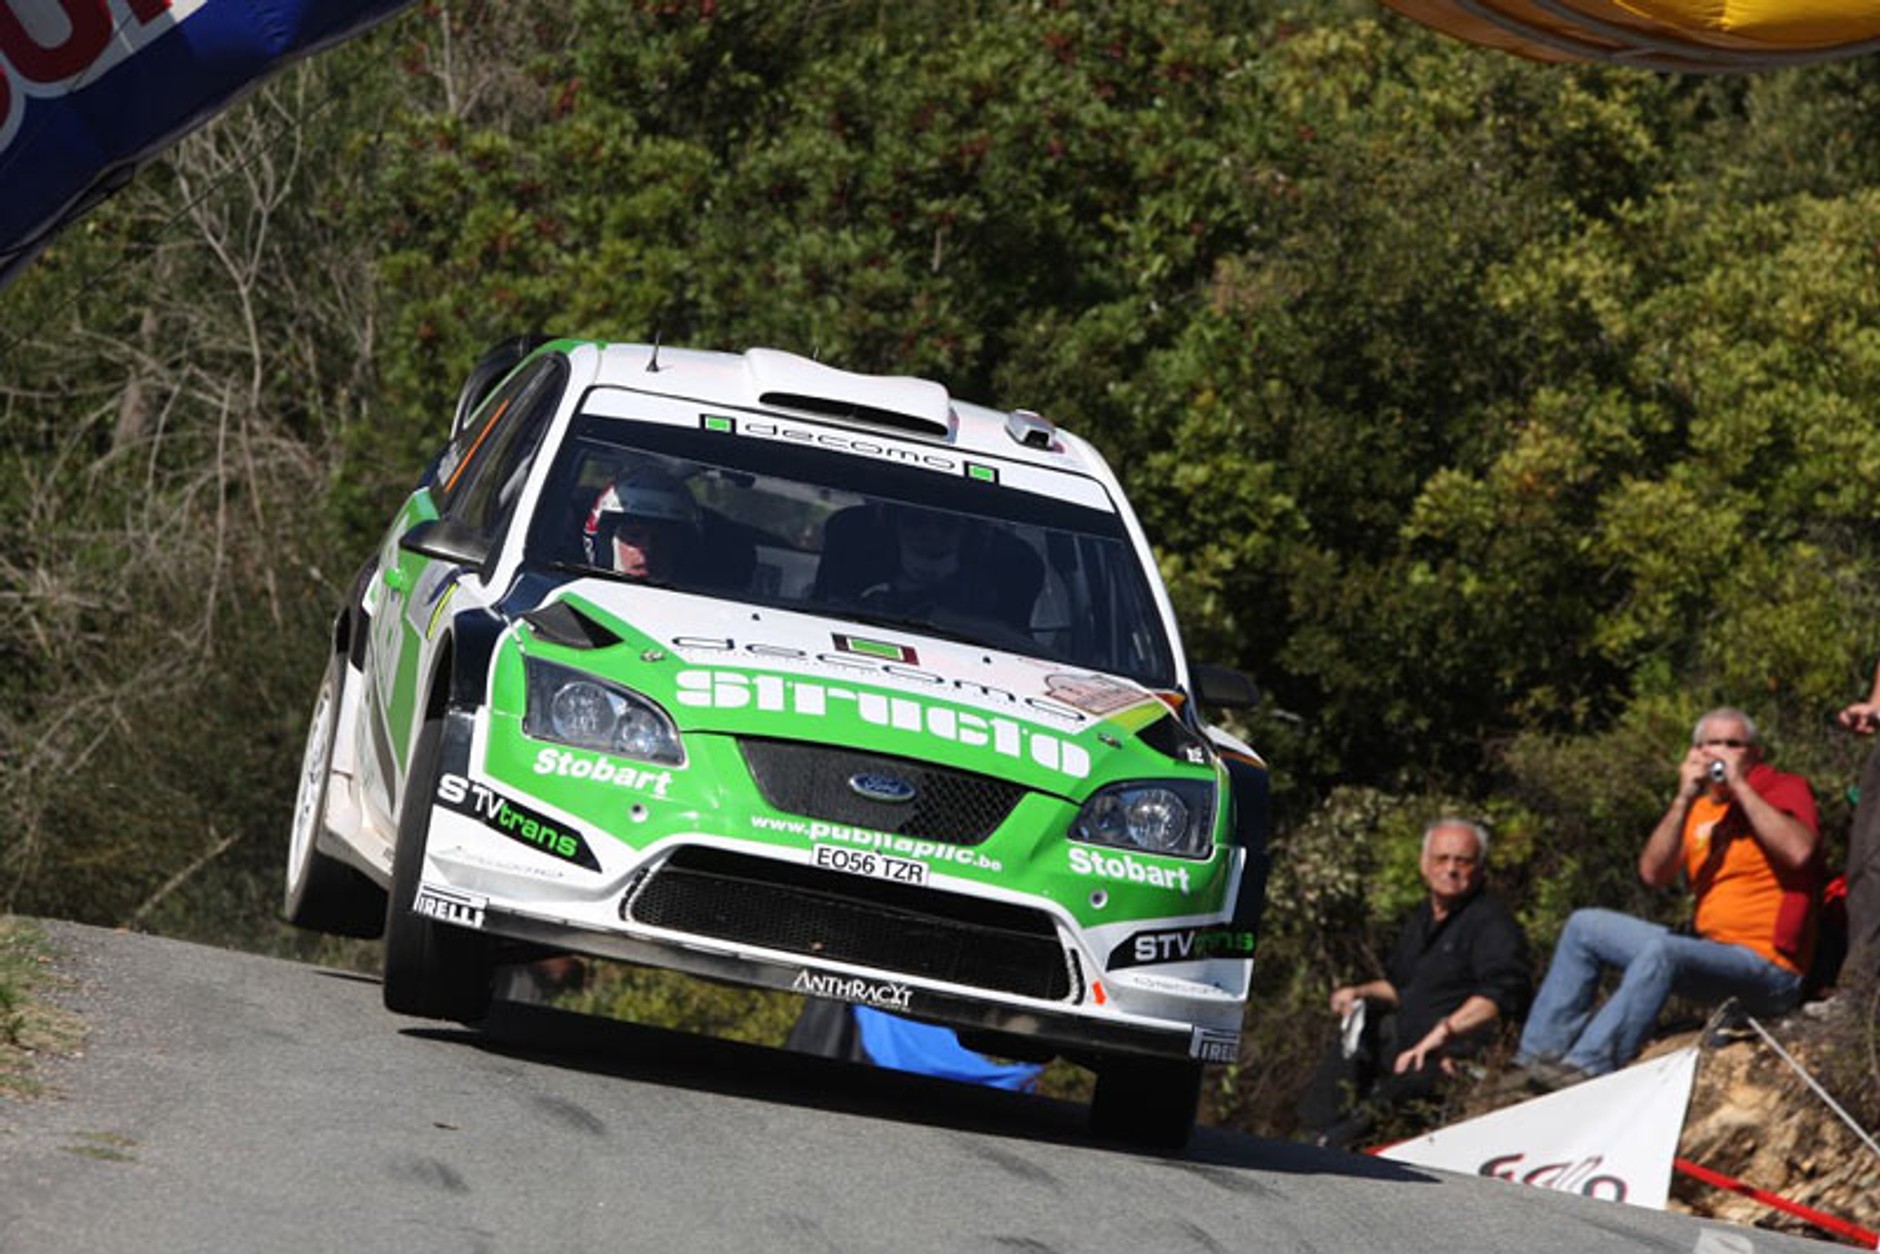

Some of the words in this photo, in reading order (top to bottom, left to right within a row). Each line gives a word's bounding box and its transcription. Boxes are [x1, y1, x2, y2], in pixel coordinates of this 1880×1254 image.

[533, 747, 673, 799] Stobart
[816, 847, 876, 875] EO56
[883, 858, 924, 883] TZR
[1068, 847, 1190, 895] Stobart
